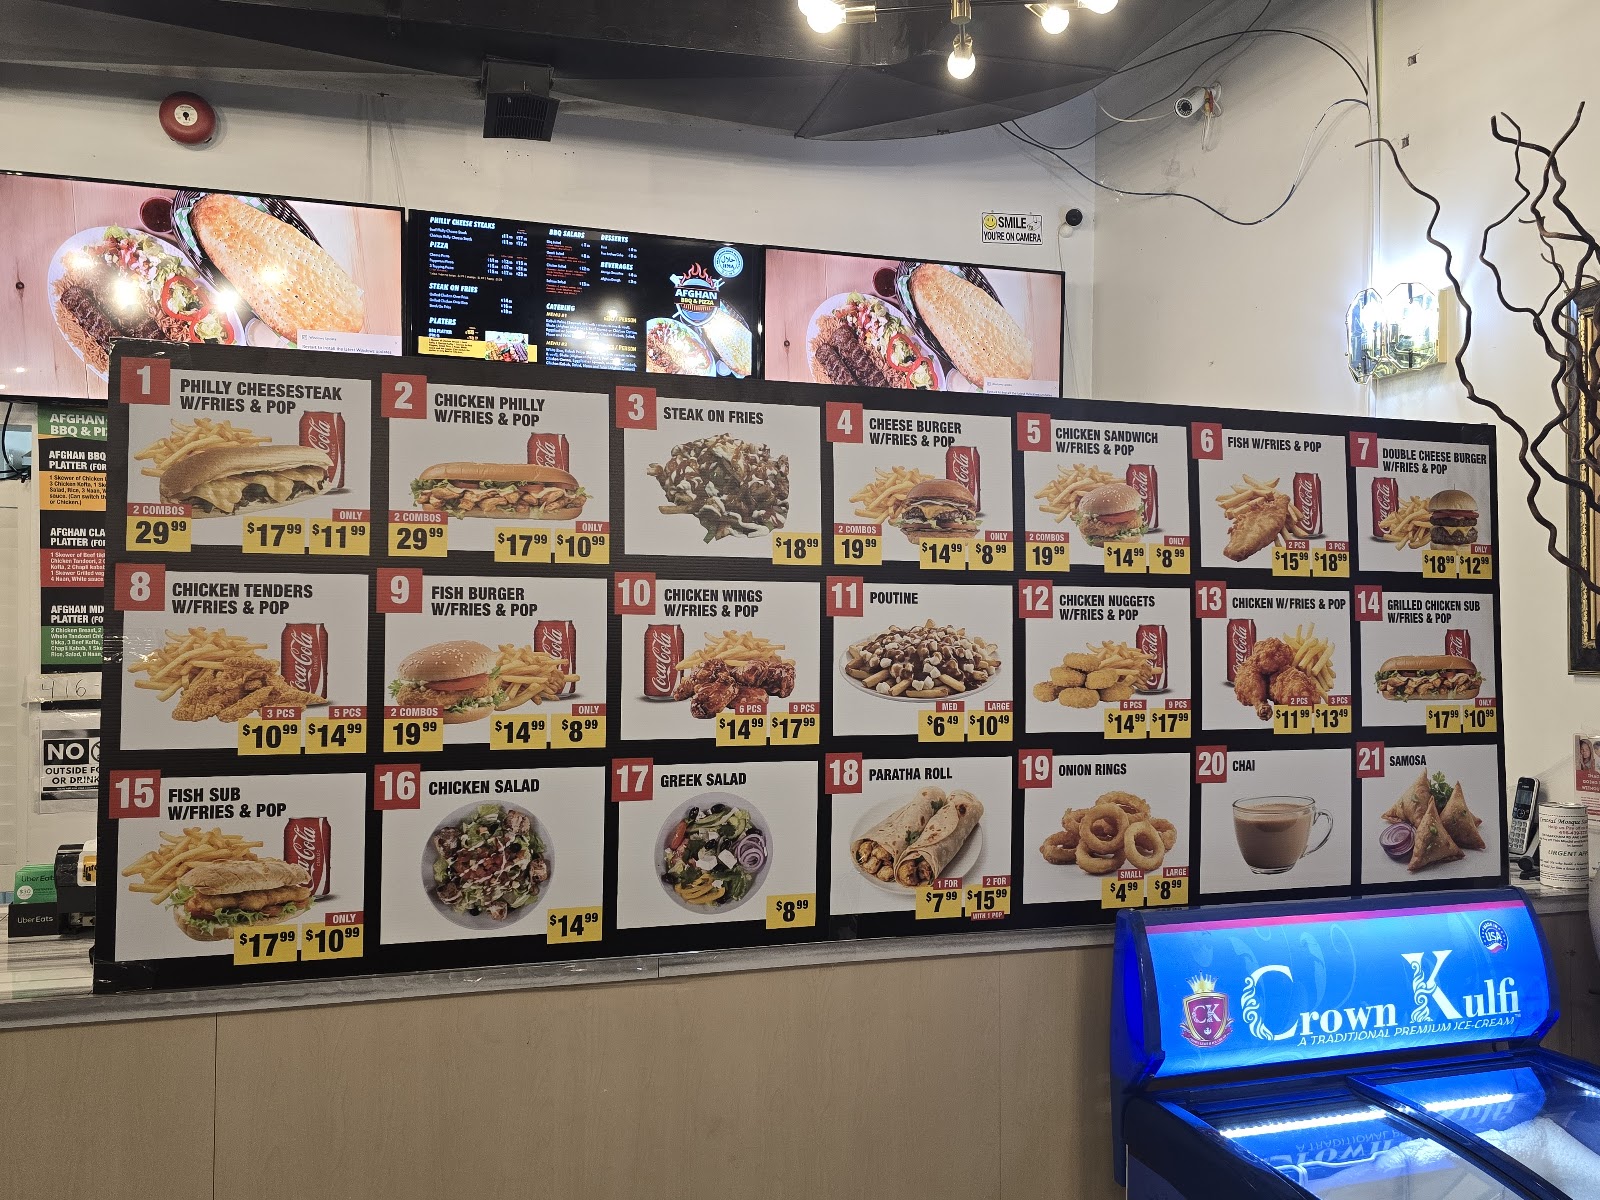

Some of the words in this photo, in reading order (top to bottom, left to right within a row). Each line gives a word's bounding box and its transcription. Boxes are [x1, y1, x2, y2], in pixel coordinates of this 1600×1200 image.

[452, 219, 472, 227] CHEESE
[473, 221, 495, 229] STEAKS
[998, 217, 1026, 228] SMILE
[563, 230, 585, 238] SALADS
[601, 234, 628, 243] DESSERTS
[984, 231, 1004, 240] YOU'RE
[1006, 232, 1014, 241] ON
[1016, 233, 1041, 242] CAMERA
[430, 241, 448, 249] PIZZA
[601, 262, 633, 270] BEVERAGES
[429, 283, 449, 291] STEAK
[675, 289, 717, 299] AFGHAN
[546, 303, 575, 311] CATERING
[137, 366, 150, 394] 1
[180, 379, 232, 395] PHILLY
[237, 382, 342, 400] CHEESESTEAK
[394, 381, 413, 409] 2
[180, 396, 244, 412] W/FRIES
[250, 399, 261, 413] &
[267, 400, 296, 414] POP
[435, 393, 494, 409] CHICKEN
[500, 397, 545, 412] PHILLY
[628, 394, 644, 420] 3
[50, 414, 104, 424] AFGHAN
[664, 407, 704, 421] STEAK
[708, 410, 724, 422] ON
[729, 411, 763, 424] FRIES
[837, 410, 852, 434] 4
[51, 425, 77, 437] BBQ
[81, 427, 91, 436] &
[870, 418, 913, 431] CHEESE
[917, 420, 961, 434] BURGER
[1027, 419, 1041, 444] 5
[1056, 428, 1100, 440] CHICKEN
[1104, 431, 1158, 443] SANDWICH
[1201, 429, 1214, 452] 6
[1228, 437, 1249, 448] FISH
[1252, 438, 1291, 450] W/FRIES
[1294, 441, 1301, 451] &
[1304, 441, 1321, 452] POP
[1358, 438, 1369, 460] 7
[49, 451, 85, 460] AFGHAN
[88, 452, 106, 461] BBQ
[1383, 448, 1416, 460] DOUBLE
[1419, 451, 1451, 462] CHEESE
[1454, 453, 1486, 464] BURGER
[49, 461, 87, 470] PLATTER
[133, 506, 138, 514] 2
[143, 506, 184, 515] COMBOS
[339, 511, 362, 520] ONLY
[50, 528, 86, 536] AFGHAN
[582, 523, 603, 531] ONLY
[846, 526, 876, 534] COMBOS
[51, 538, 88, 546] PLATTER
[130, 572, 150, 601] 8
[172, 583, 239, 598] CHICKEN
[244, 584, 313, 598] TENDERS
[390, 576, 409, 604] 9
[432, 586, 463, 600] FISH
[469, 587, 524, 600] BURGER
[618, 579, 650, 606] 10
[664, 589, 718, 602] CHICKEN
[723, 590, 763, 602] WINGS
[832, 583, 856, 608] 11
[870, 592, 918, 604] POUTINE
[1023, 586, 1049, 611] 12
[1060, 595, 1104, 606] CHICKEN
[1109, 595, 1155, 607] NUGGETS
[1198, 587, 1222, 611] 13
[1358, 591, 1379, 613] 14
[51, 605, 86, 613] AFGHAN
[1232, 598, 1273, 609] CHICKEN
[1276, 598, 1315, 609] W/FRIES
[1319, 599, 1325, 609] &
[1329, 599, 1346, 609] POP
[1388, 600, 1422, 610] GRILLED
[1425, 600, 1461, 611] CHICKEN
[1464, 601, 1480, 611] SUB
[51, 615, 88, 623] PLATTER
[48, 743, 84, 760] NO
[1359, 748, 1381, 770] 21
[1023, 756, 1049, 780] 19
[1198, 752, 1225, 776] 20
[1232, 760, 1255, 772] CHAI
[1390, 755, 1426, 766] SAMOSA
[830, 760, 858, 785] 18
[869, 768, 920, 781] PARATHA
[925, 768, 952, 780] ROLL
[1059, 764, 1091, 776] ONION
[1095, 764, 1127, 775] RINGS
[379, 771, 415, 800] 16
[617, 765, 649, 793] 17
[661, 774, 702, 787] GREEK
[706, 773, 746, 786] SALAD
[115, 778, 154, 809] 15
[429, 781, 490, 795] CHICKEN
[495, 779, 539, 793] SALAD
[168, 788, 204, 803] FISH
[209, 788, 240, 801] SUB
[1485, 932, 1502, 941] USA
[1240, 964, 1398, 1041] Crown
[1401, 949, 1521, 1022] Kulfi
[1192, 1004, 1221, 1023] CK
[1297, 1037, 1307, 1047] A
[1311, 1029, 1390, 1045] TRADITIONAL
[1394, 1024, 1451, 1037] PREMIUM
[1454, 1016, 1515, 1031] ICE-CREAM
